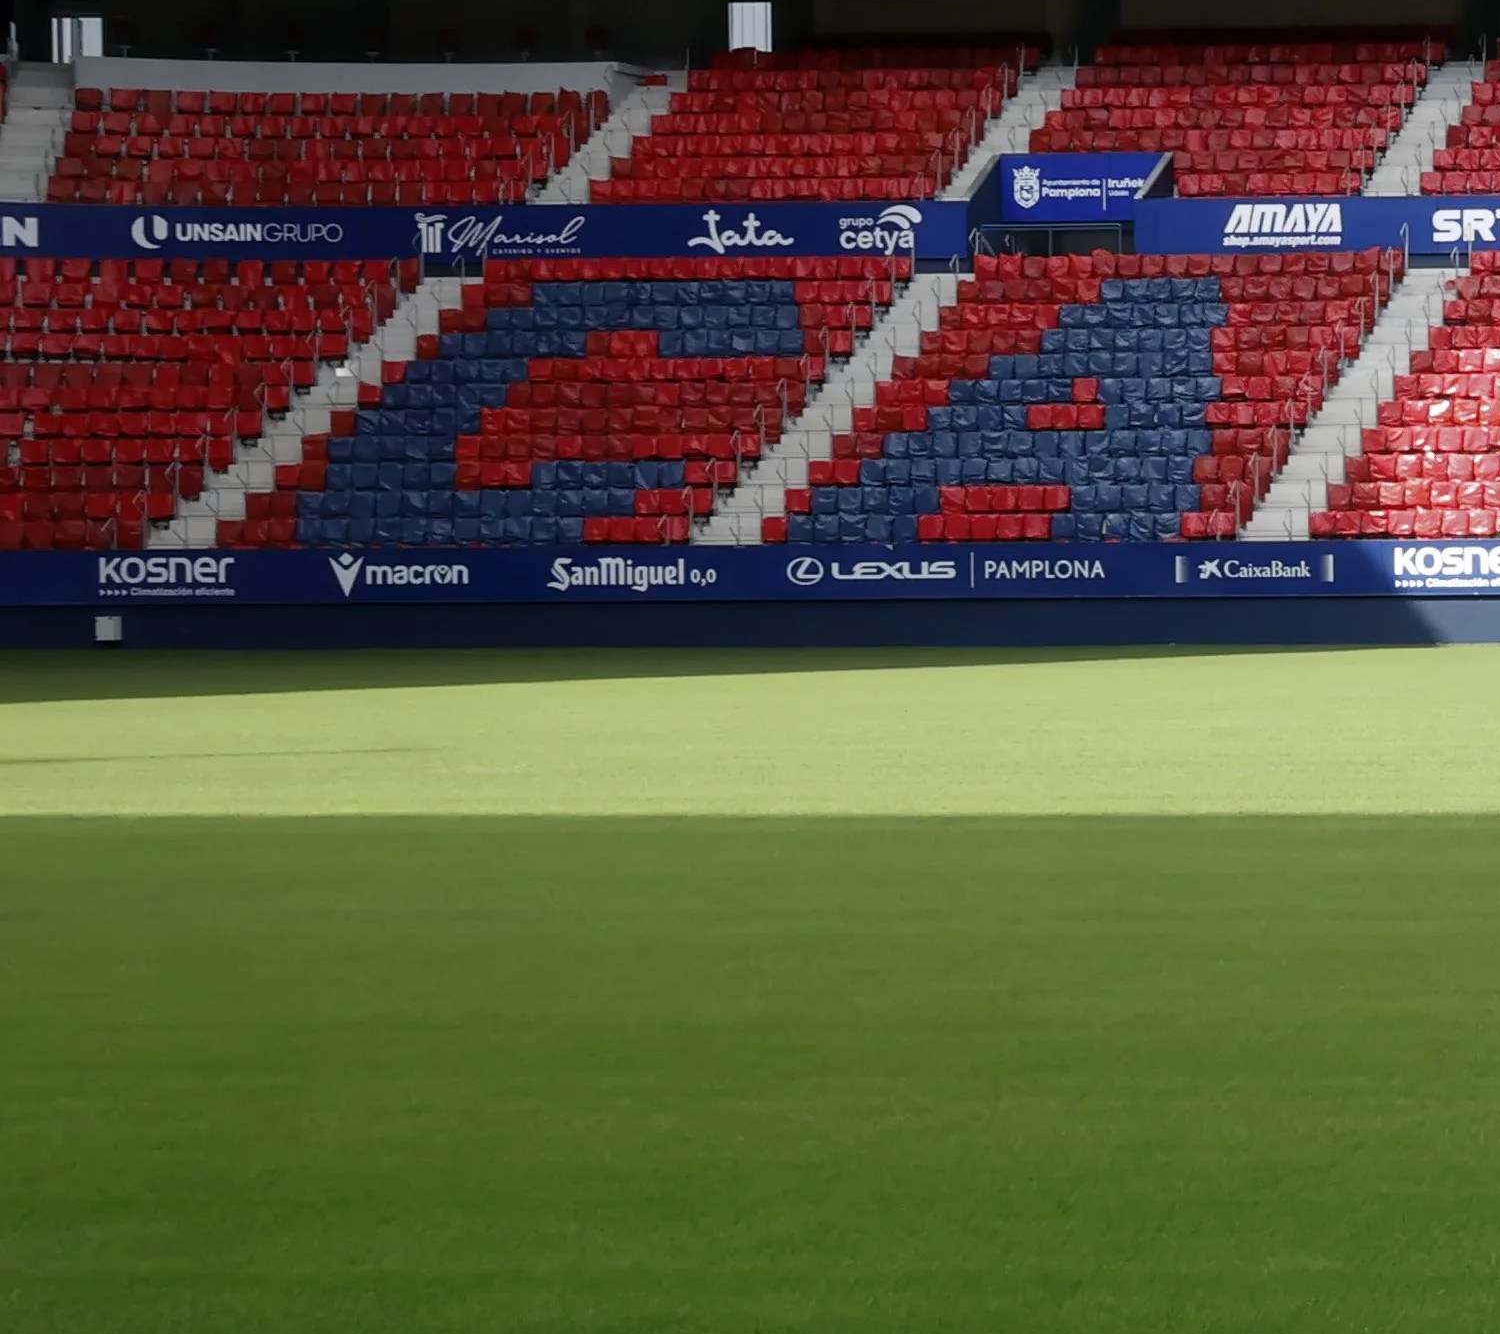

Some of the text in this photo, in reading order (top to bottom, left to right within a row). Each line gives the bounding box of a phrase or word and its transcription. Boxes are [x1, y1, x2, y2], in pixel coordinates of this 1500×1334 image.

[1108, 177, 1144, 189] Iruñek
[1042, 187, 1100, 199] Pamplona
[839, 218, 873, 229] grupo
[1223, 204, 1341, 233] AMAYA
[449, 215, 585, 256] Marisol
[688, 209, 793, 254] Jata
[840, 229, 913, 254] cetya
[366, 564, 468, 585] macron
[690, 569, 716, 585] 0,0
[832, 560, 1105, 579] LEXUS PAMPLONA
[1224, 560, 1311, 577] CaixaBank
